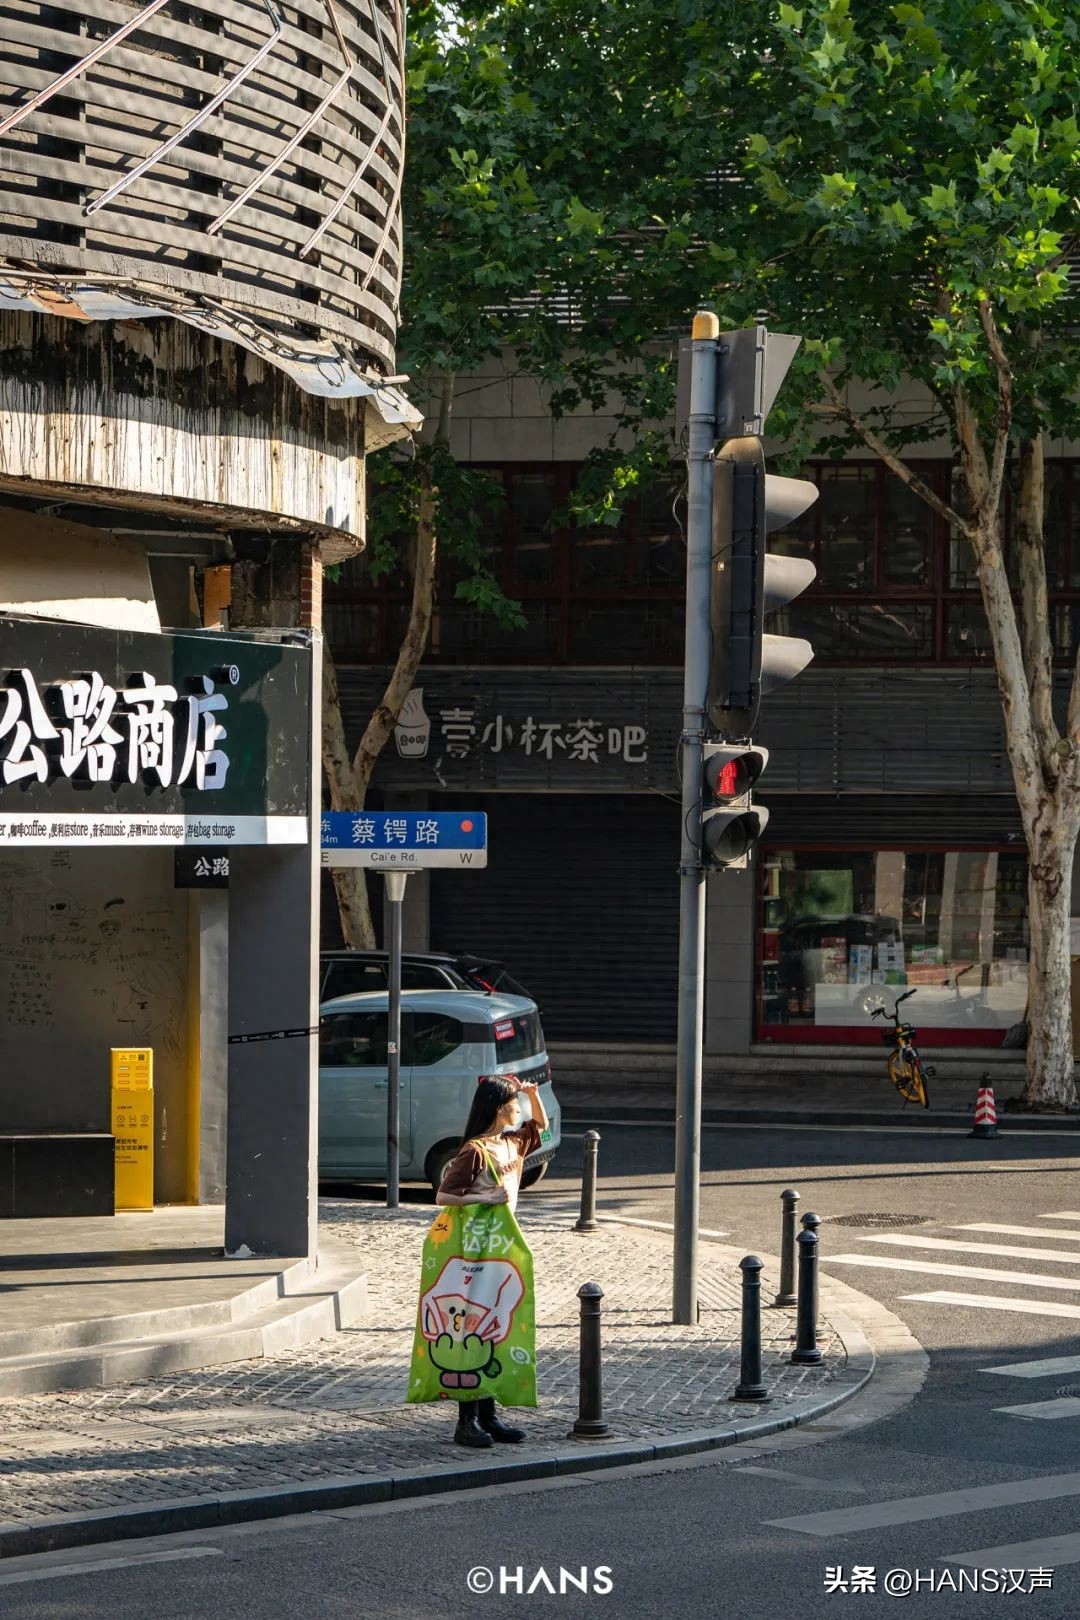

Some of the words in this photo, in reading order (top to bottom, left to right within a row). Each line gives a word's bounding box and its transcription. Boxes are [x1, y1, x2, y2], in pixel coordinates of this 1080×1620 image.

[0, 667, 230, 791] 公路商店
[160, 822, 183, 838] storage
[212, 822, 235, 838] storage
[352, 818, 440, 844] 蔡锷路
[193, 856, 230, 877] 公路
[321, 852, 329, 862] E
[371, 852, 396, 862] Cai'e
[401, 852, 418, 862] Rd.
[460, 853, 472, 863] W
